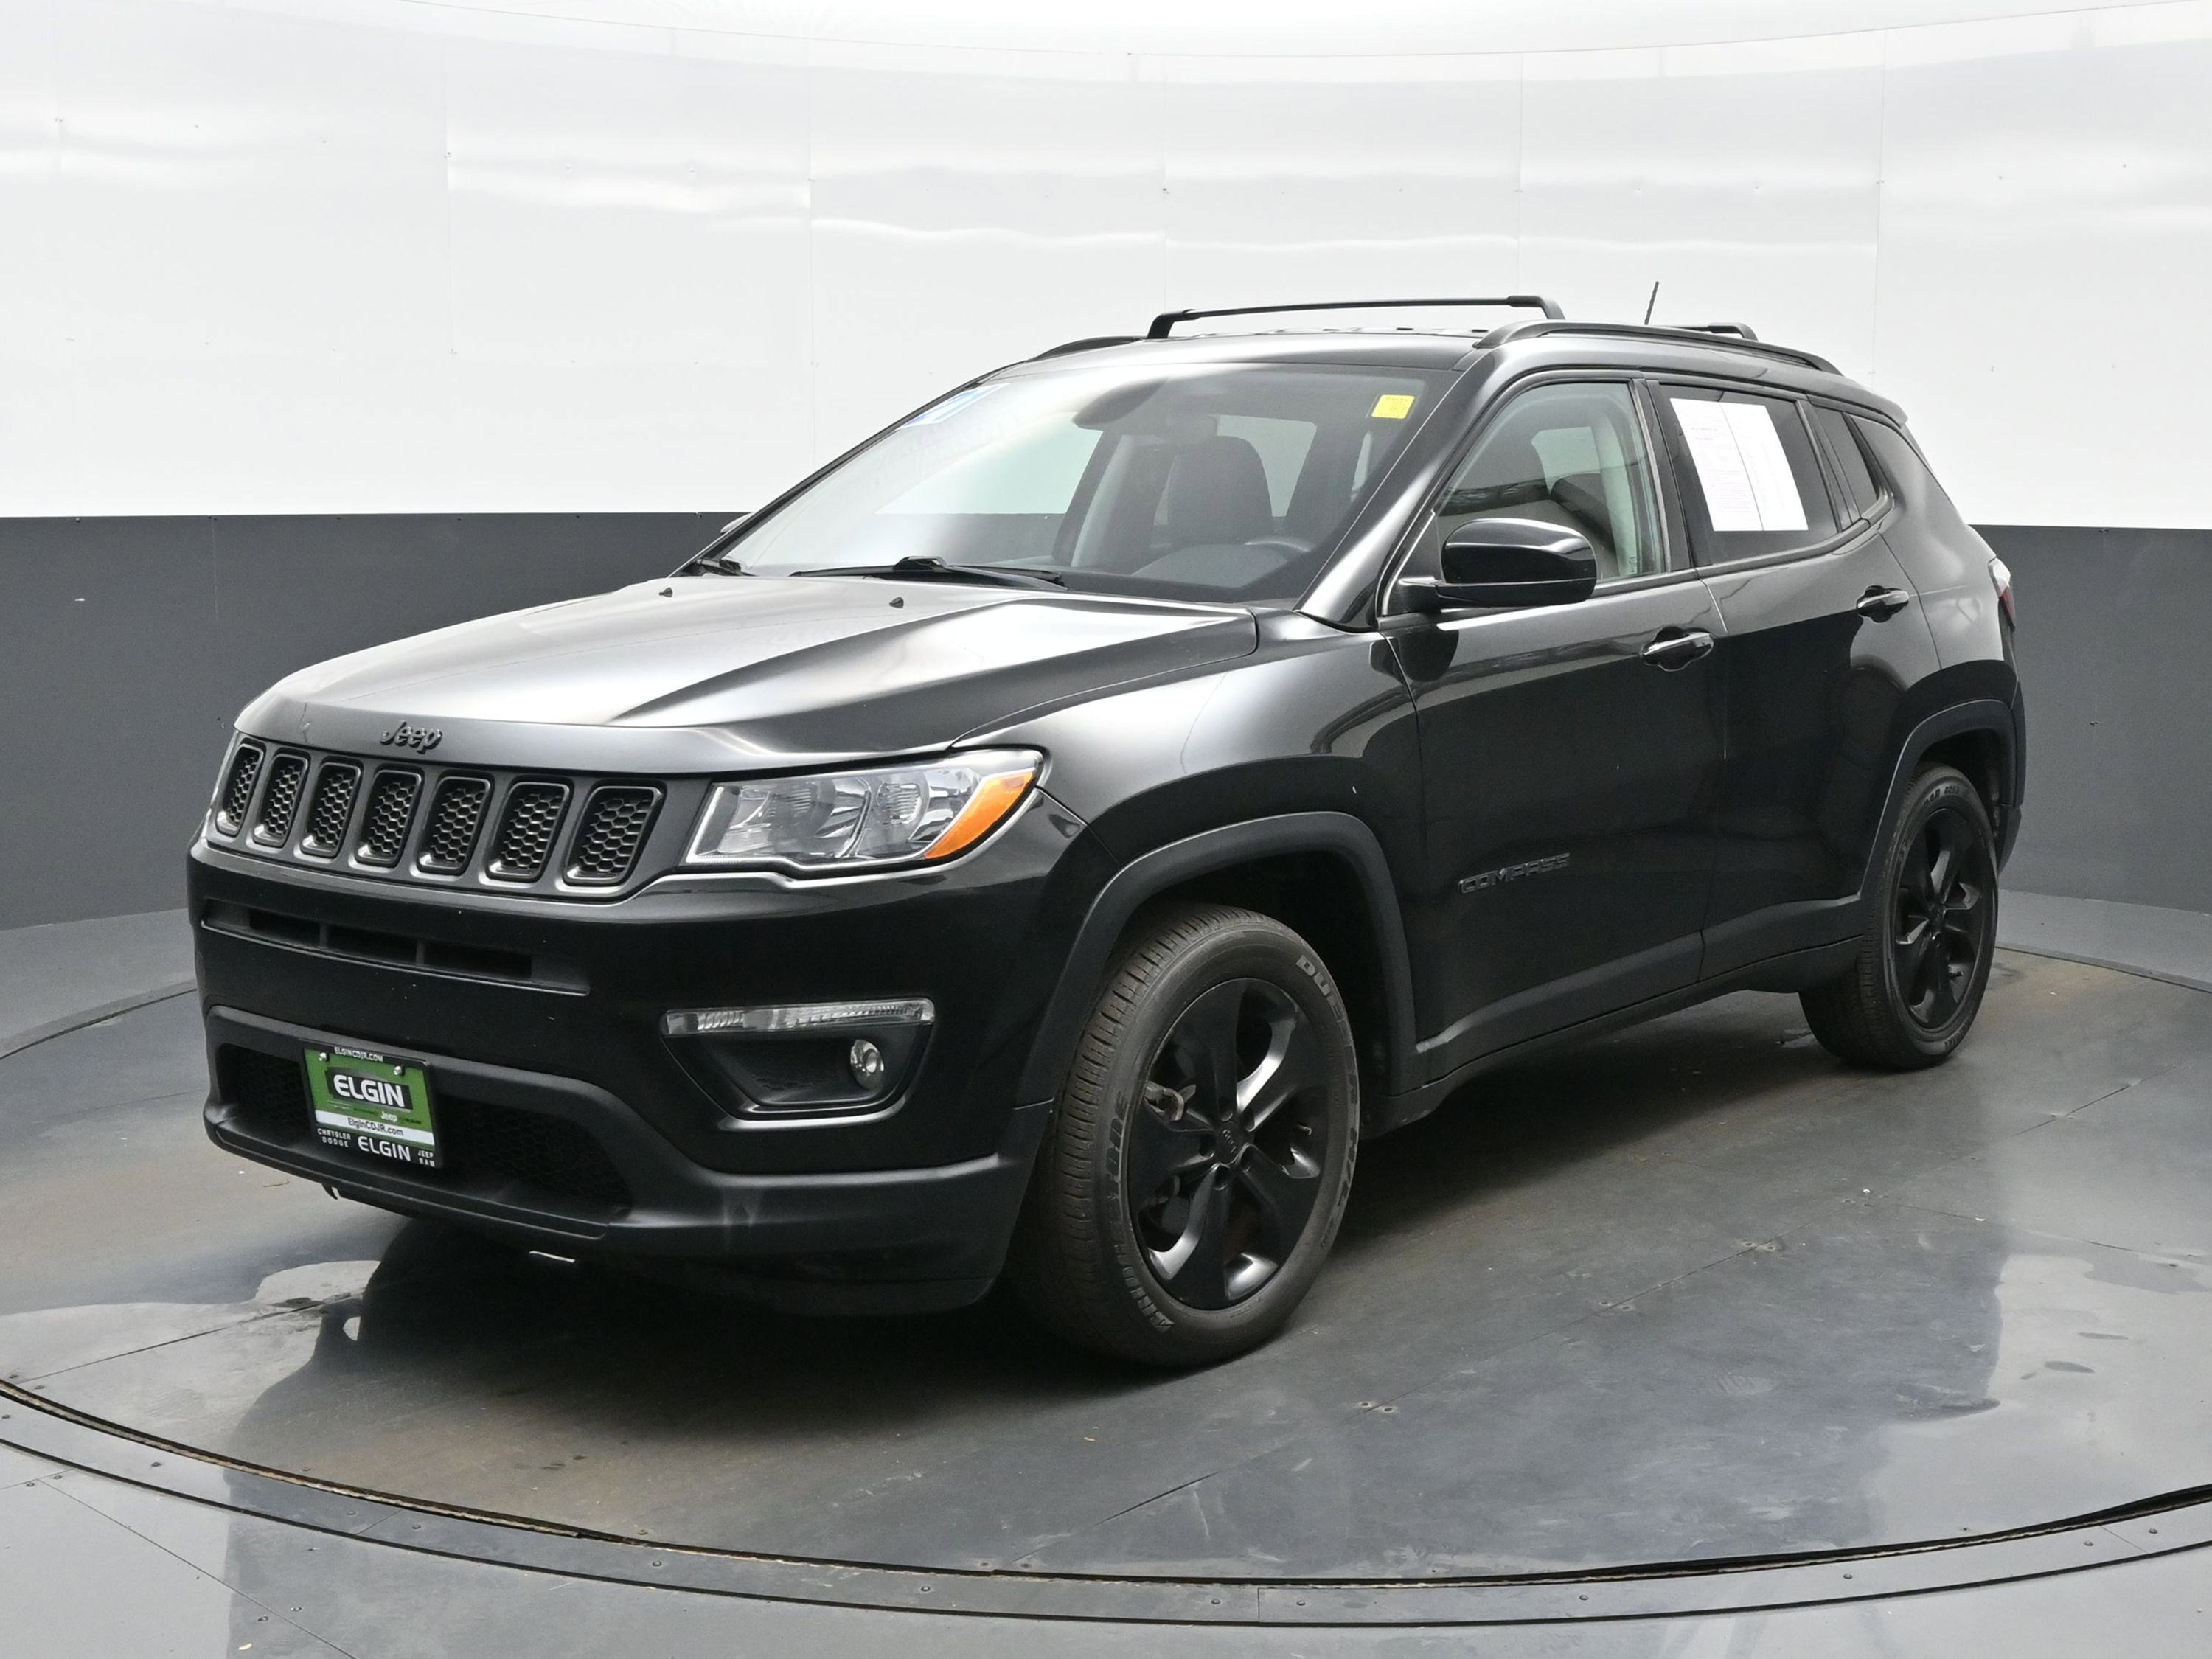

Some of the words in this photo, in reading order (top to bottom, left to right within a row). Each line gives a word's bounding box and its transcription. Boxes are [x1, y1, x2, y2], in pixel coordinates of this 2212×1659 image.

[380, 720, 442, 754] Jeep
[1458, 852, 1570, 894] COMPASS
[334, 1046, 383, 1062] ELGINCDJR.COM
[333, 1074, 405, 1107] ELGIN
[380, 1110, 397, 1123] Jeep
[317, 1127, 351, 1140] CHRYSLER
[347, 1117, 404, 1136] ElginCDJR.com
[322, 1138, 349, 1148] DODGE
[358, 1136, 411, 1162] ELGIN
[418, 1150, 434, 1158] JEEP
[419, 1157, 435, 1167] RAM
